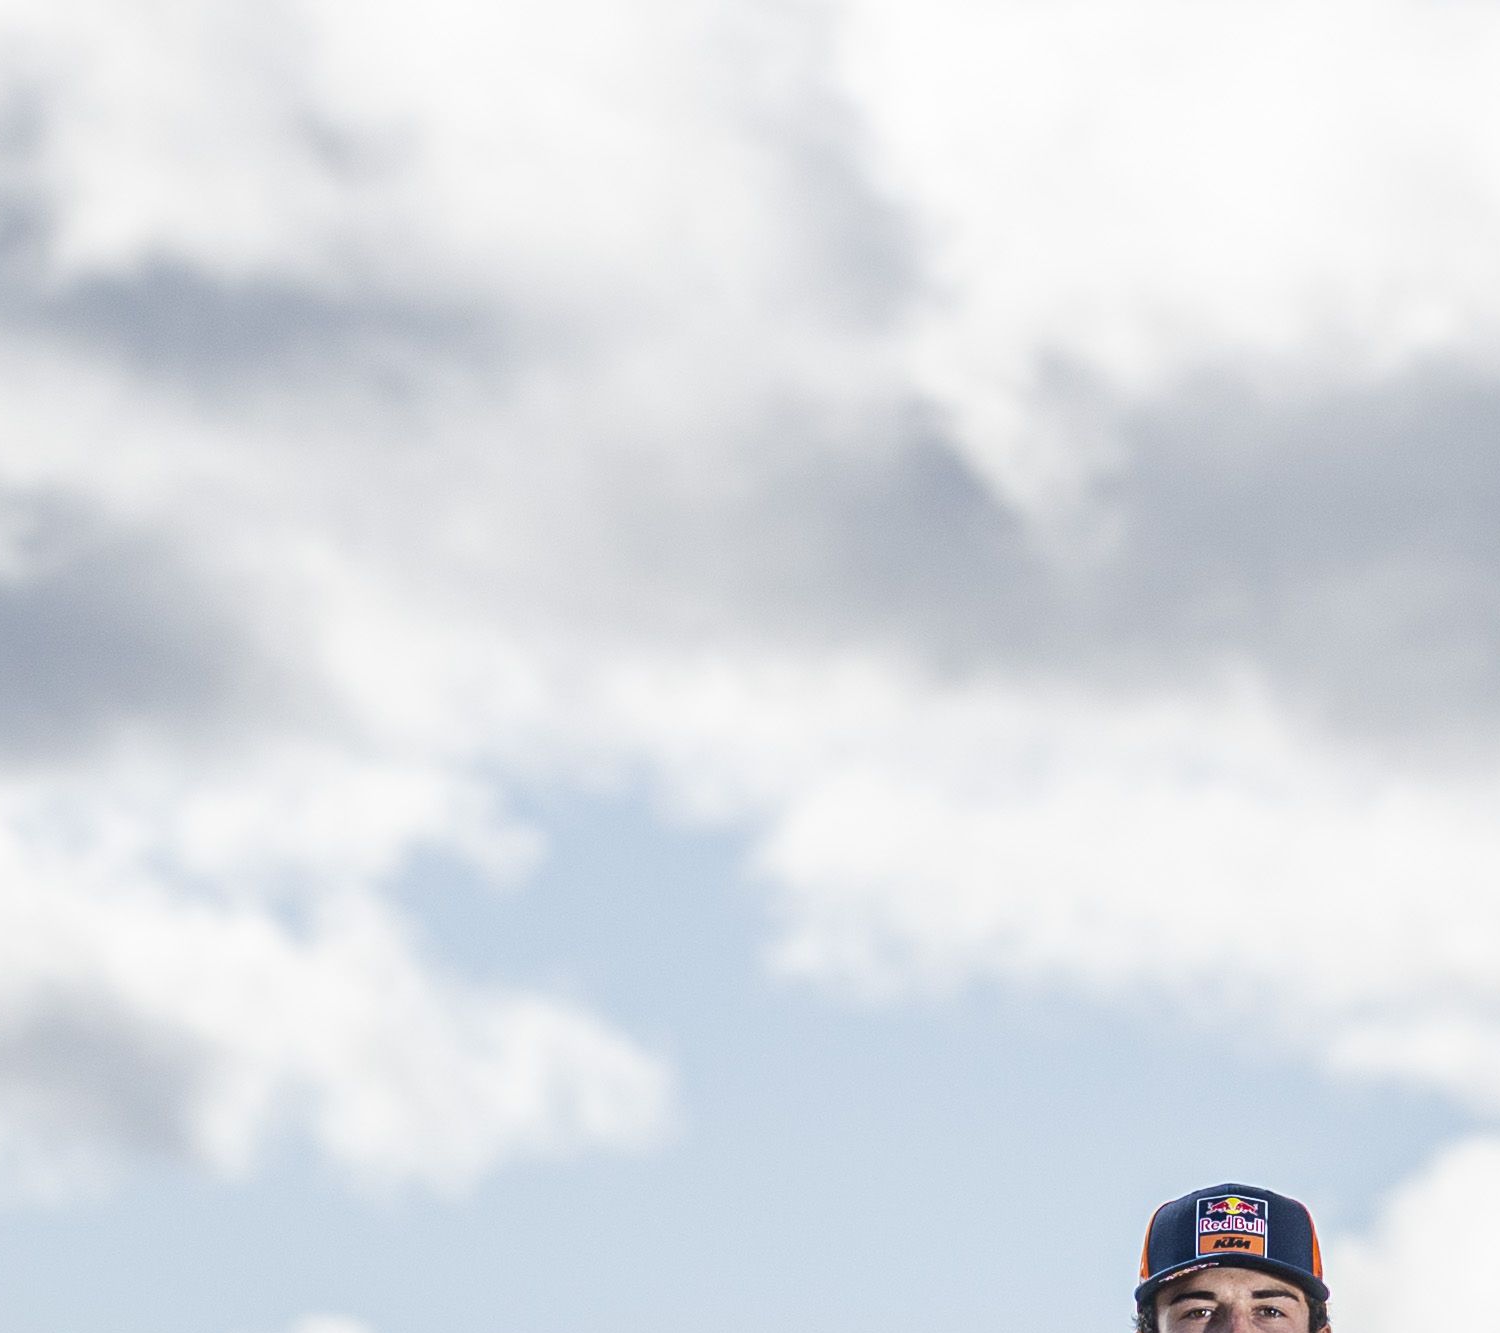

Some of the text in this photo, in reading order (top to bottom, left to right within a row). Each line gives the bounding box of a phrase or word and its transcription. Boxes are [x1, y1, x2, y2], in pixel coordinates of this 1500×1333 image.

[1200, 1215, 1264, 1235] Red Bull
[1213, 1237, 1251, 1249] KTM
